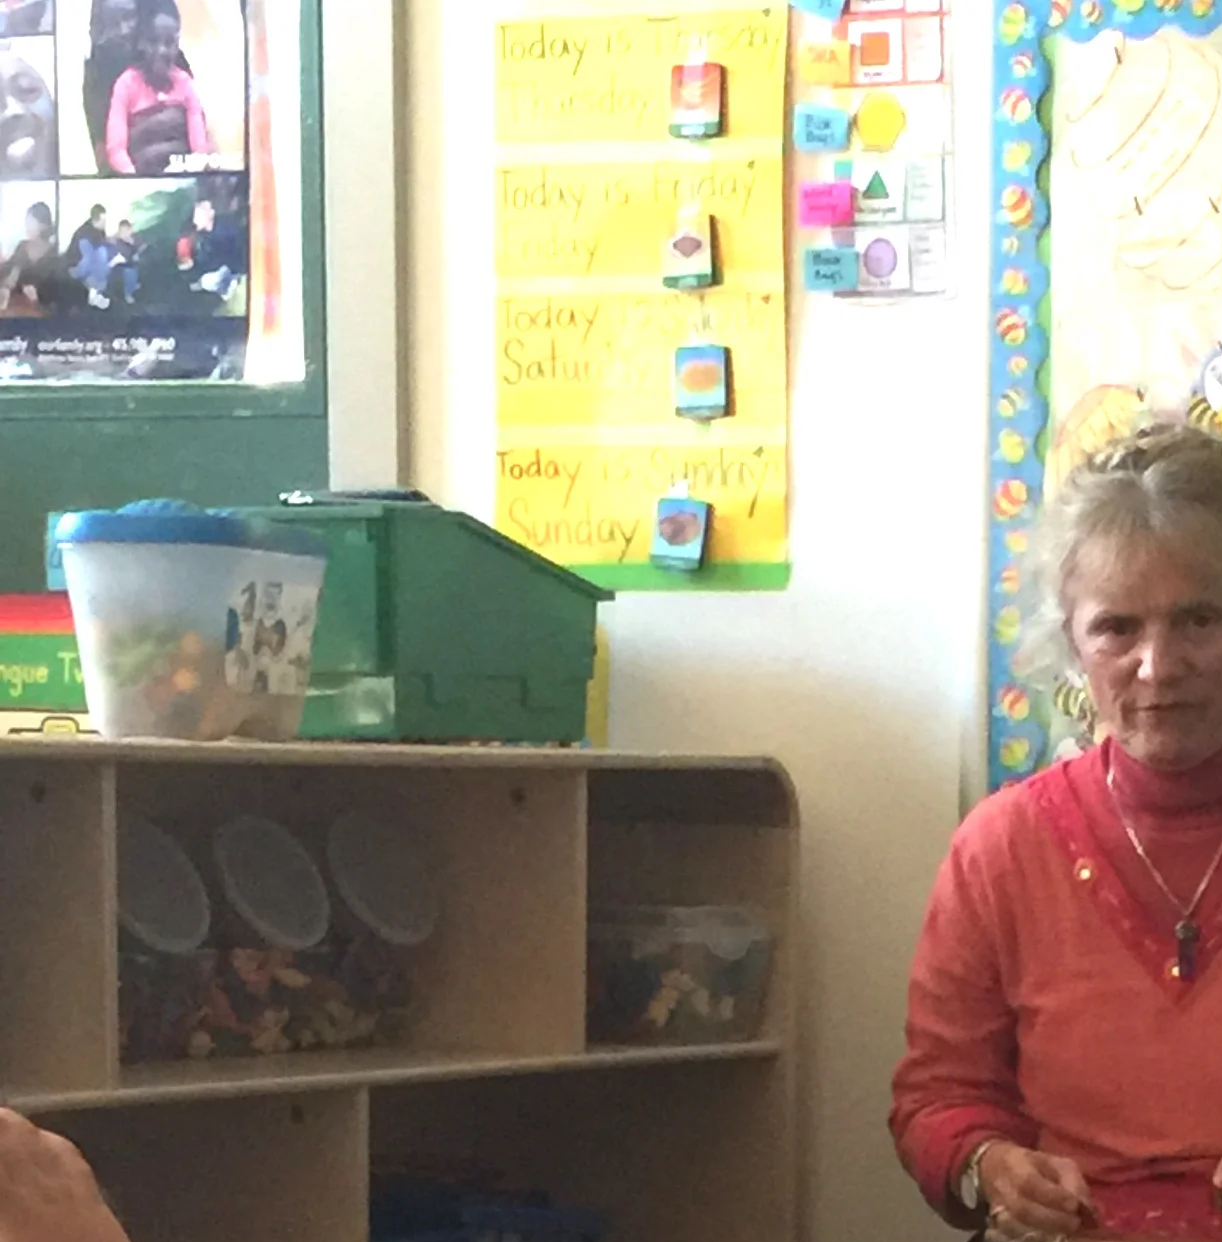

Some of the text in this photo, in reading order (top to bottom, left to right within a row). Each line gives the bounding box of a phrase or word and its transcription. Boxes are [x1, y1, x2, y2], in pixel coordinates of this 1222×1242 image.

[499, 22, 588, 77] Today
[605, 28, 633, 55] is
[500, 71, 654, 128] Thursday
[500, 165, 586, 223] Today
[603, 177, 631, 207] is
[653, 161, 757, 216] Friday
[503, 220, 600, 275] Friday
[502, 296, 600, 346] Today
[496, 448, 582, 511] Today
[601, 457, 632, 482] is
[508, 497, 640, 564] Sunday
